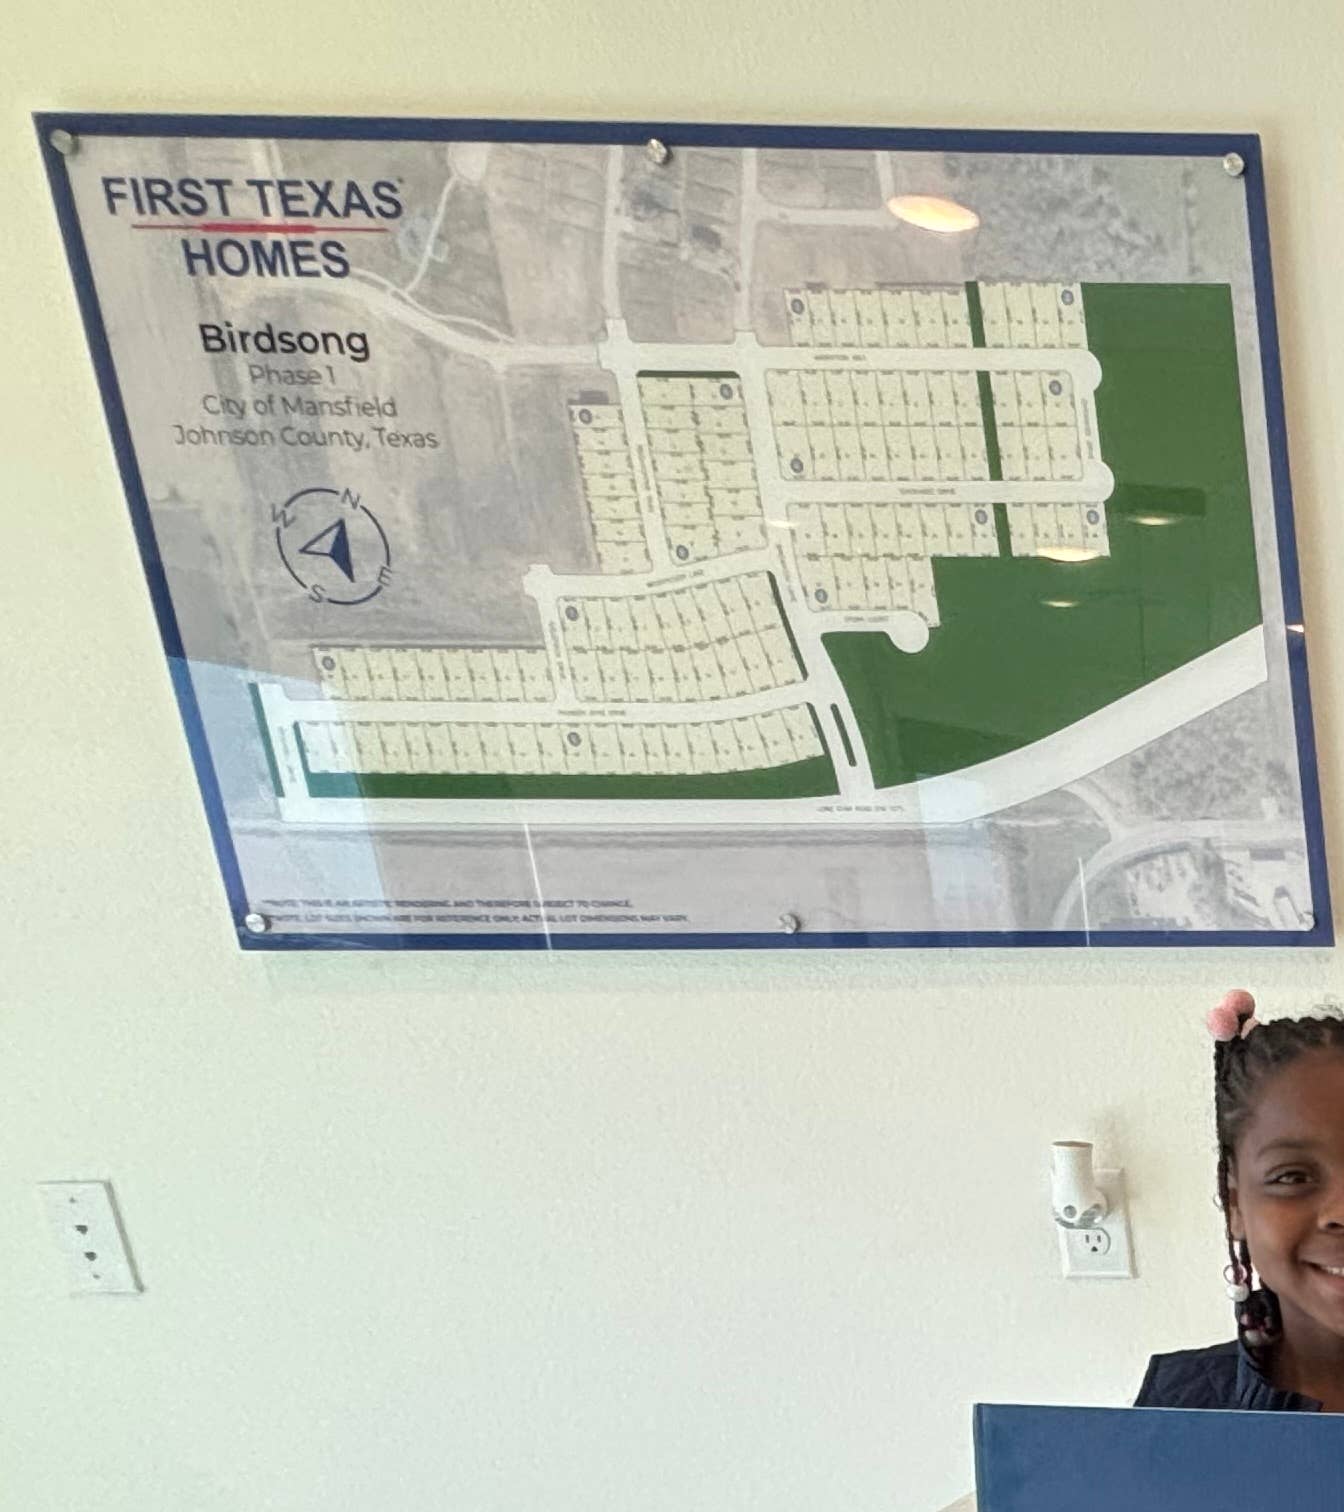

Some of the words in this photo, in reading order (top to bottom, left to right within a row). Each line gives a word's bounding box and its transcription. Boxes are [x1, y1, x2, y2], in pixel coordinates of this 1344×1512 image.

[101, 177, 233, 216] FIRST
[245, 179, 403, 219] TEXAS
[181, 238, 350, 278] HOMES
[198, 321, 370, 363] Birdsong
[249, 364, 322, 386] Phase
[325, 365, 336, 385] 1
[202, 395, 247, 420] City
[254, 394, 275, 417] of
[282, 395, 397, 419] Mansfield
[172, 424, 276, 446] Johnson
[280, 425, 372, 450] County,
[374, 426, 440, 449] Texas
[341, 487, 360, 510] N
[271, 503, 297, 528] W
[377, 565, 393, 587] E
[308, 584, 326, 603] S
